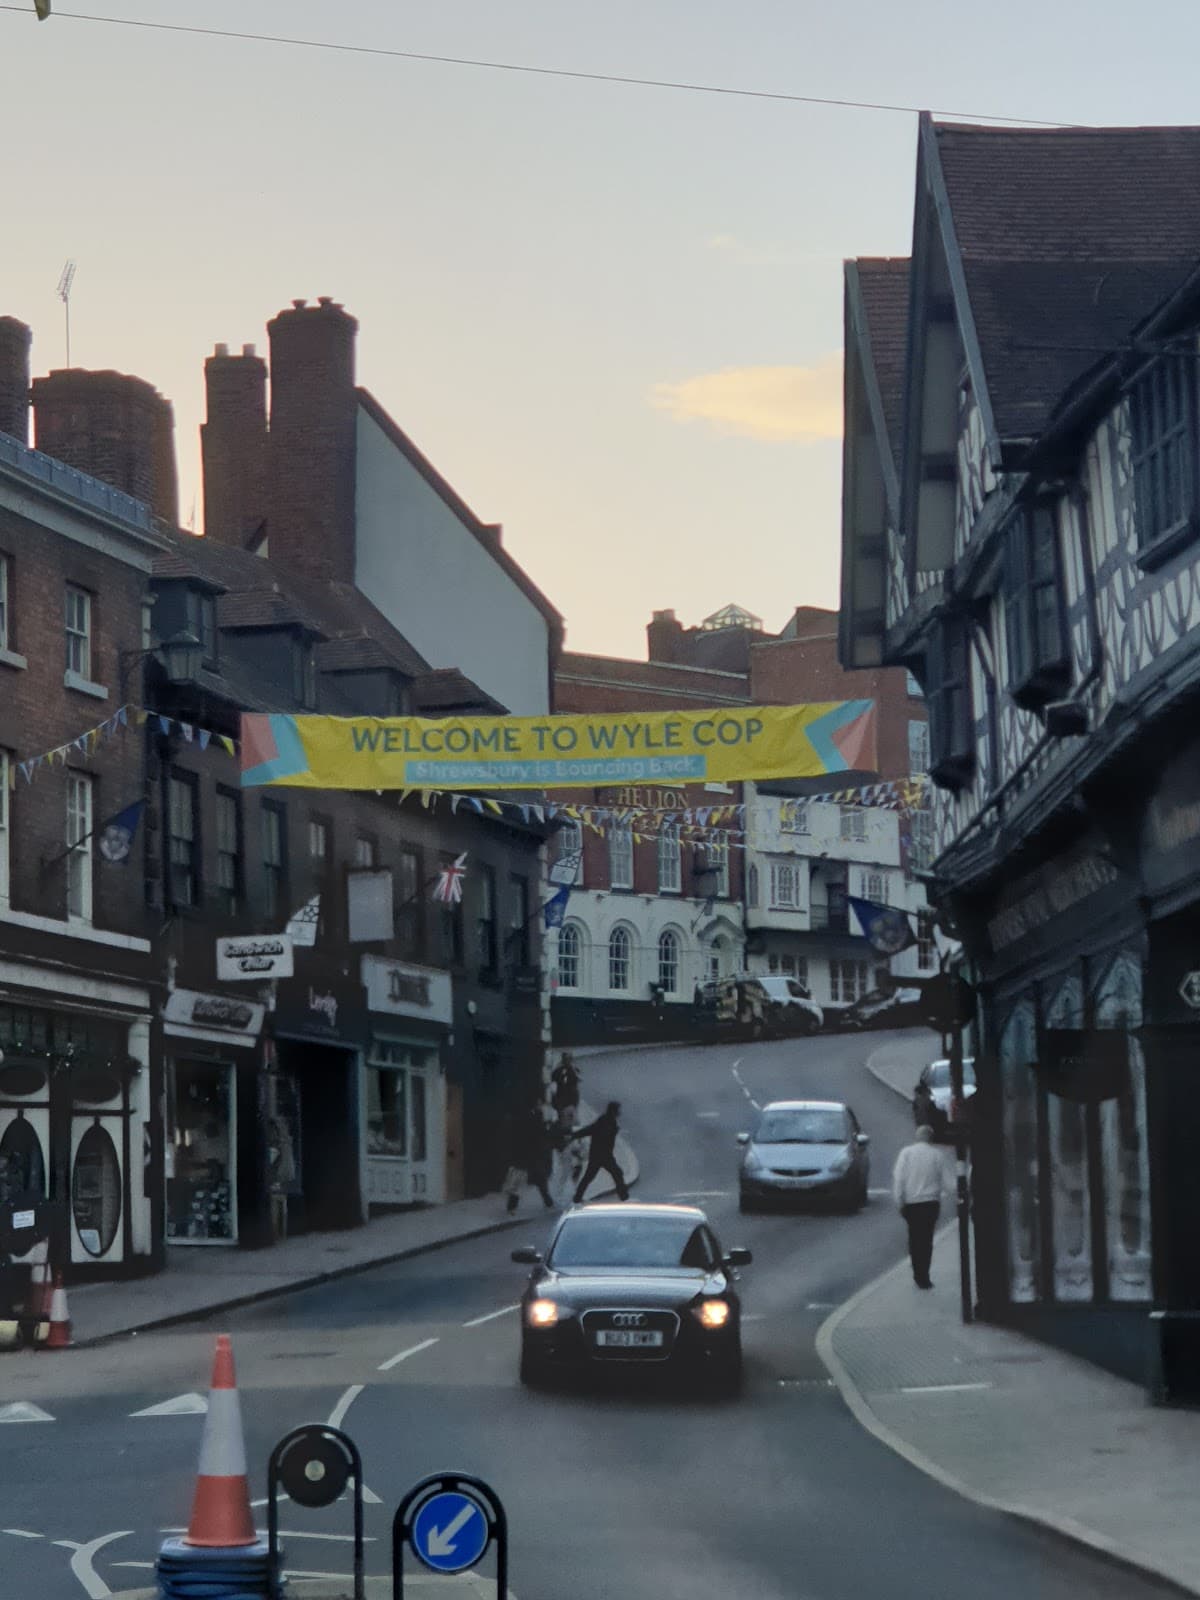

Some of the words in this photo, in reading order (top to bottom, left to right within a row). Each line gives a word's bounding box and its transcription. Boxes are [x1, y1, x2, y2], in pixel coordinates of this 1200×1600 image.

[351, 726, 522, 753] WELCOME
[531, 725, 578, 751] TO
[588, 722, 682, 749] WYLE
[692, 717, 764, 746] COP
[416, 761, 528, 780] Shrewsbury
[535, 761, 551, 778] is
[555, 757, 644, 778] Bouncing
[649, 757, 694, 775] Back
[646, 788, 689, 809] LION
